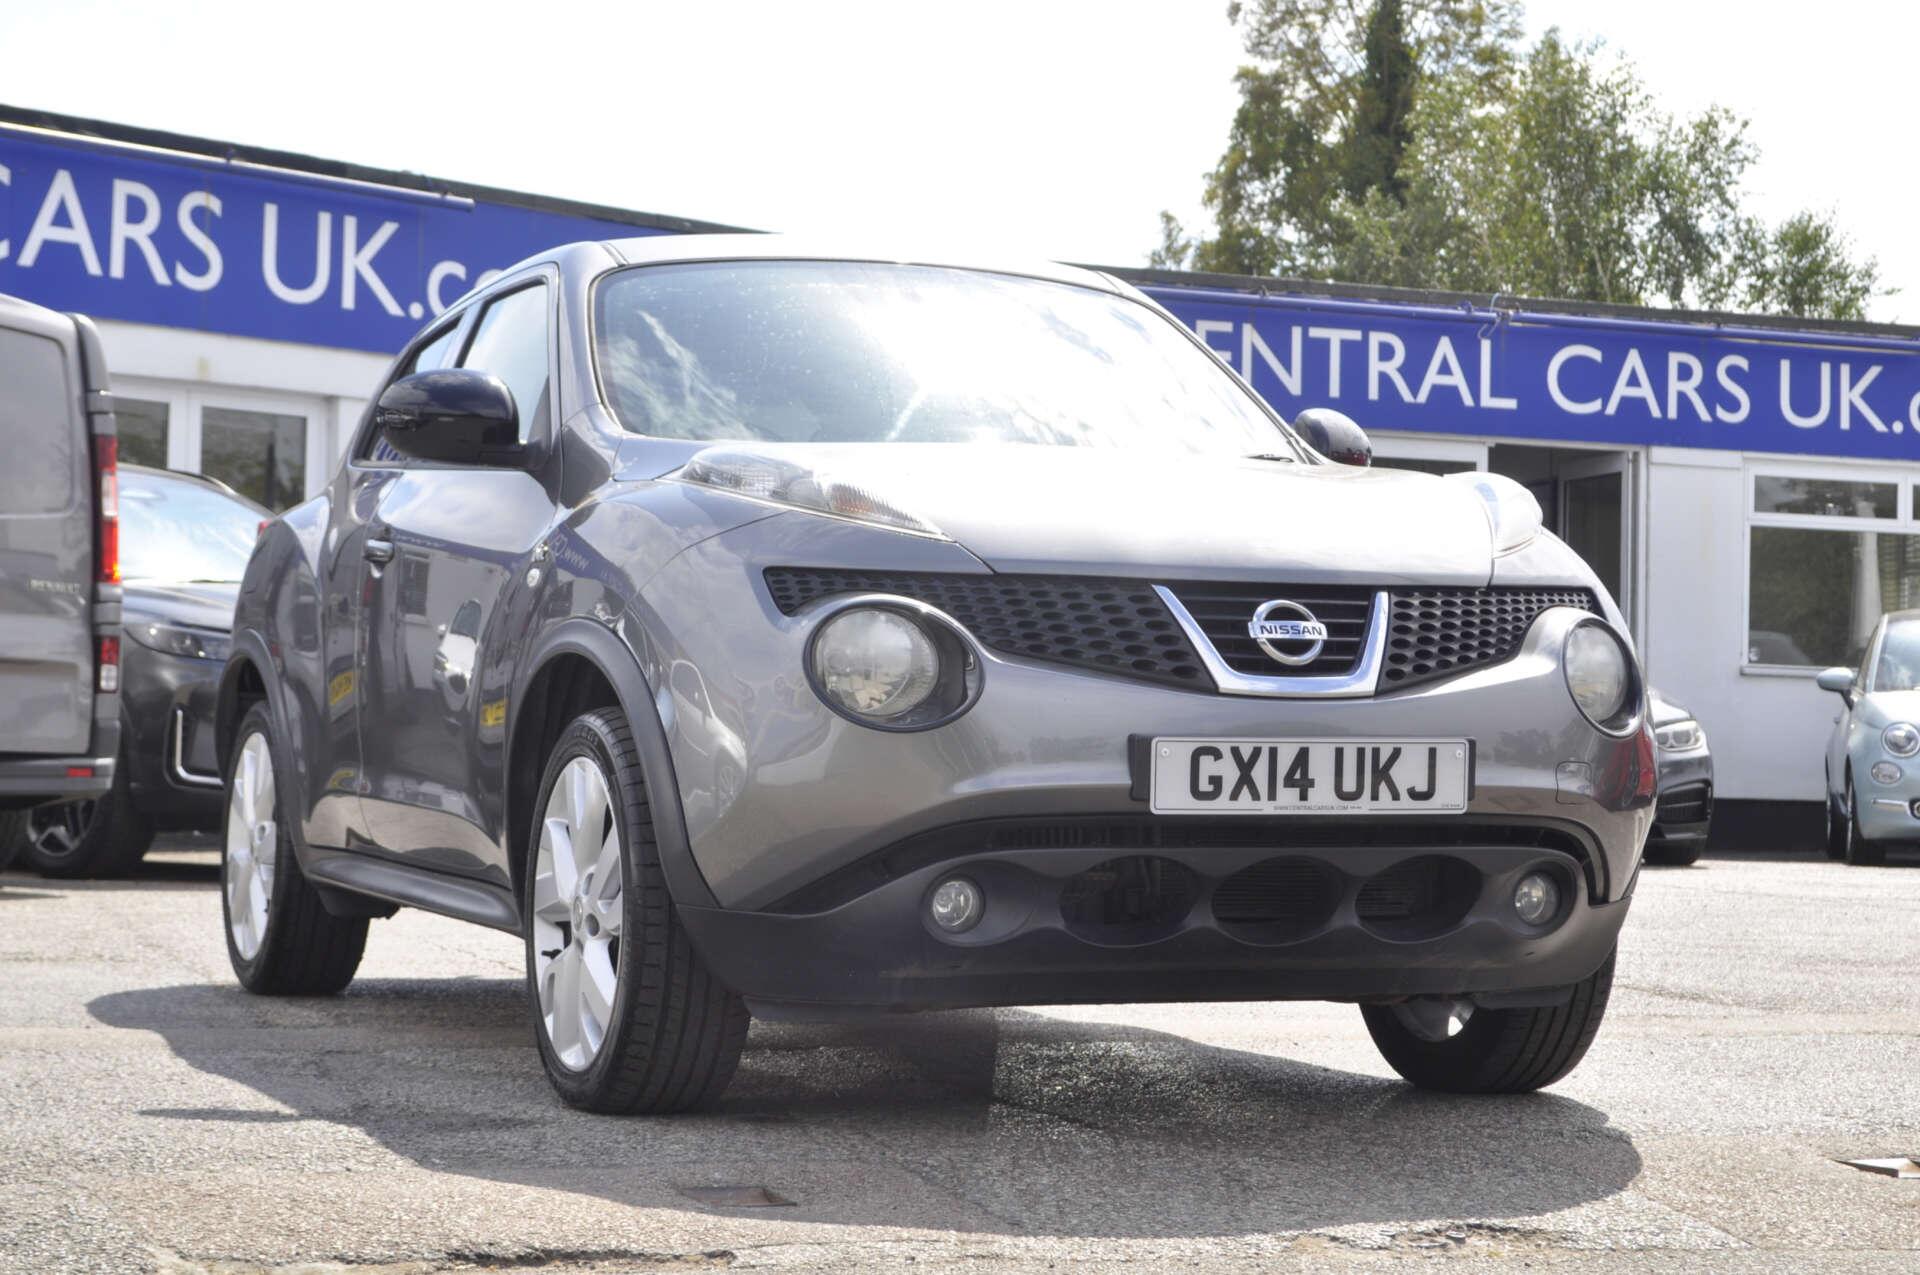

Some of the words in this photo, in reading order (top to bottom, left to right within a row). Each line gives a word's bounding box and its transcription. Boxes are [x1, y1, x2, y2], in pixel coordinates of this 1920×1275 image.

[0, 163, 223, 292] ARS
[262, 203, 505, 320] UK.c
[1546, 344, 1751, 424] CARS
[1780, 359, 1920, 435] UK.
[1259, 623, 1323, 637] NISSAN
[1190, 746, 1315, 802] GX14
[1334, 746, 1438, 802] UKJ
